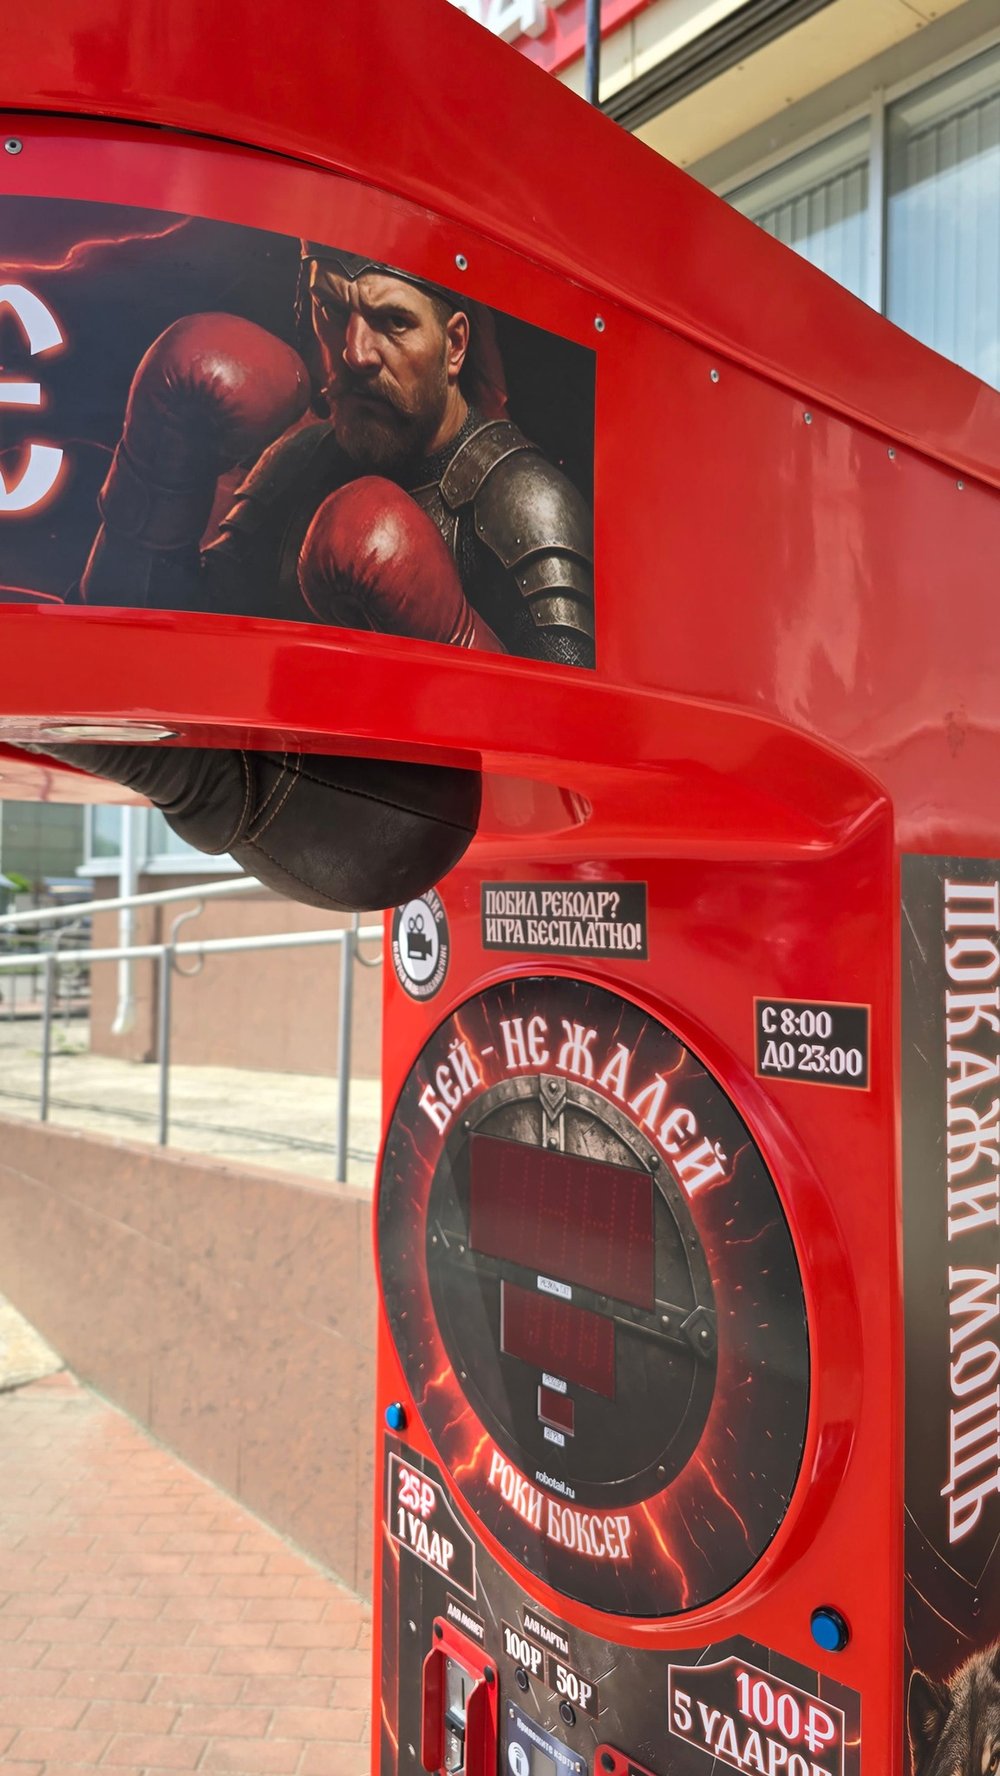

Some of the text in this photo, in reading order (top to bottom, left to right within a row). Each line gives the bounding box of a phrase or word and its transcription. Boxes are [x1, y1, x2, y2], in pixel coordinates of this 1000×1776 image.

[485, 890, 620, 921] ПОБИЛ РЕКОДР?
[485, 918, 642, 950] ИГРА БЕСПЛАТНО!
[761, 1006, 832, 1038] С 8:00
[761, 1040, 862, 1077] ДО 23:00
[418, 1038, 480, 1135] БЕЙ
[500, 1016, 549, 1069] НЕ
[556, 1019, 727, 1198] ЖАЛЕЙ
[940, 879, 1000, 1543] ПОКАЖИ МОЩЬ
[535, 1470, 575, 1499] robotail.ru
[488, 1450, 630, 1558] РОКИ БОКСЕР
[524, 1614, 569, 1655] ДЛЯ КАРТЫ
